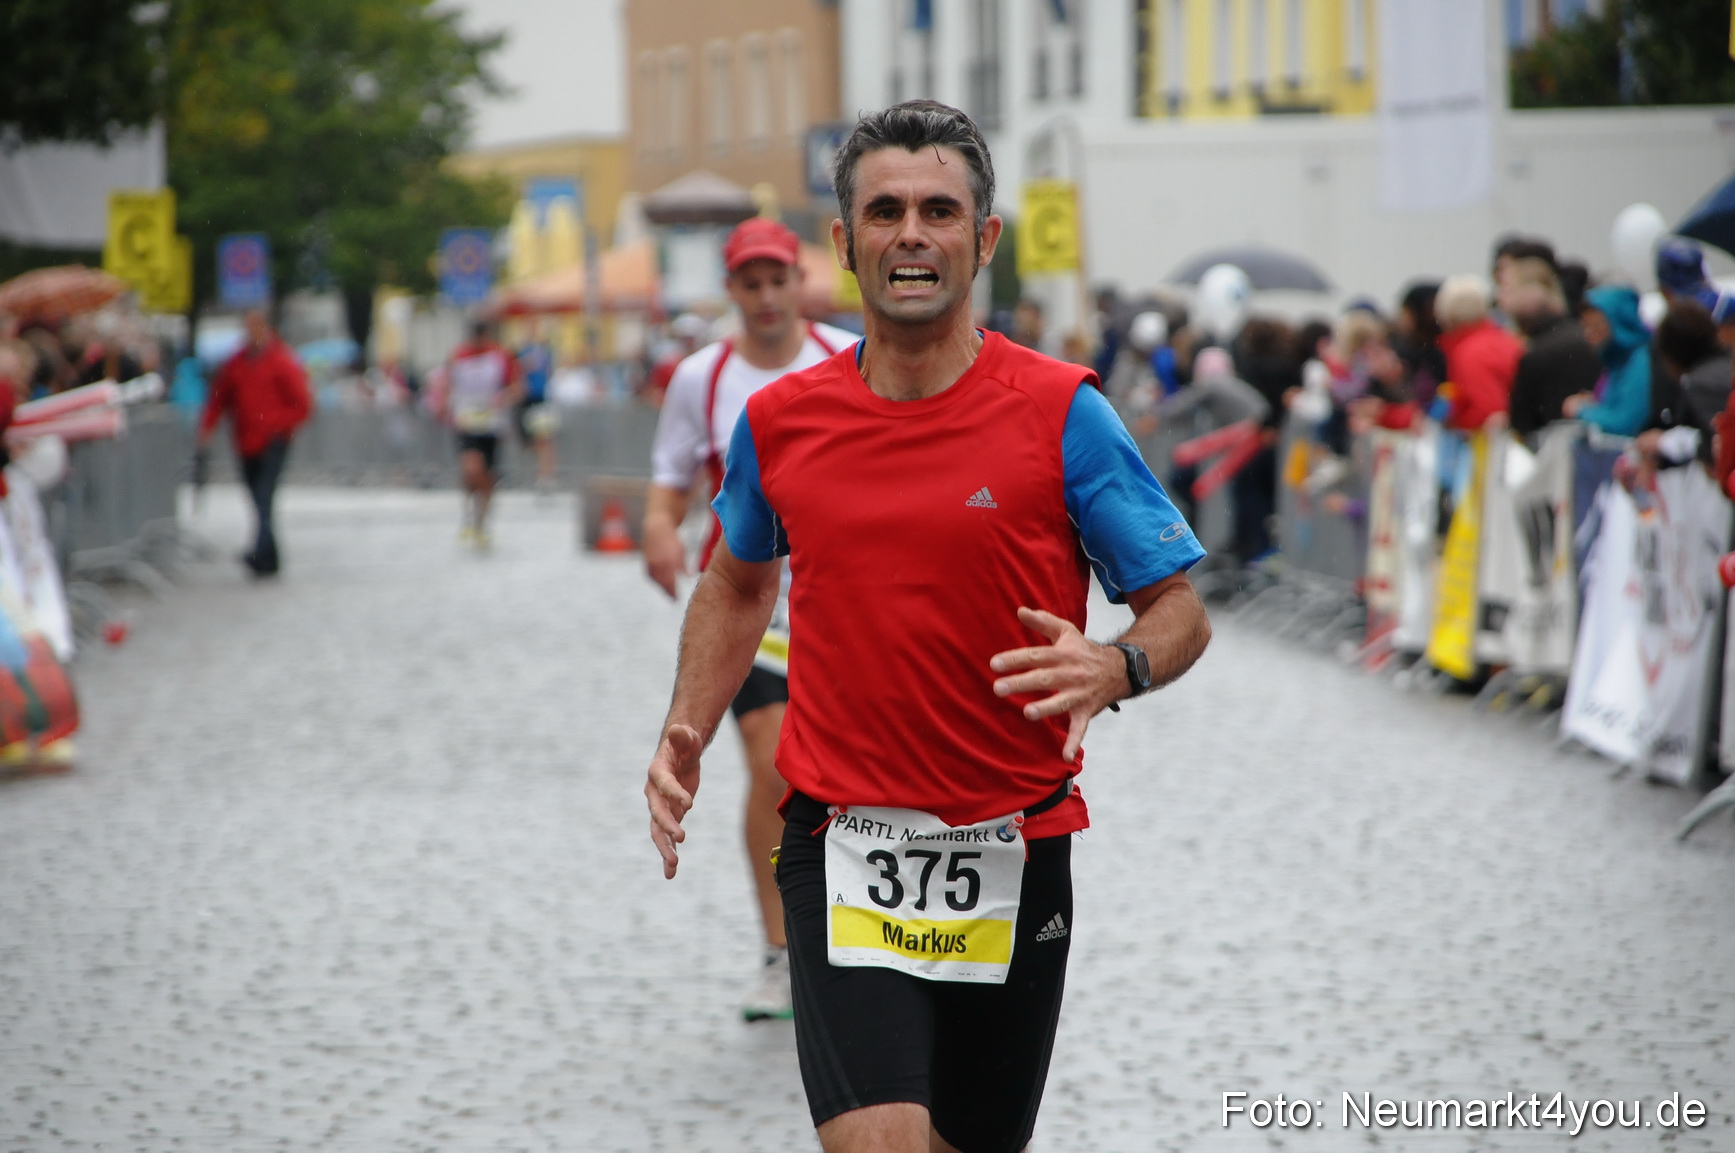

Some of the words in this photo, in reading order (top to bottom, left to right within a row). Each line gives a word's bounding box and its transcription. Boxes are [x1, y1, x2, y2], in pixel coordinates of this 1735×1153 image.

[965, 499, 998, 509] adidas
[836, 814, 896, 840] PARTL
[866, 849, 981, 911] 375
[836, 893, 845, 904] A
[882, 922, 967, 954] Markus
[1036, 927, 1068, 942] adidas
